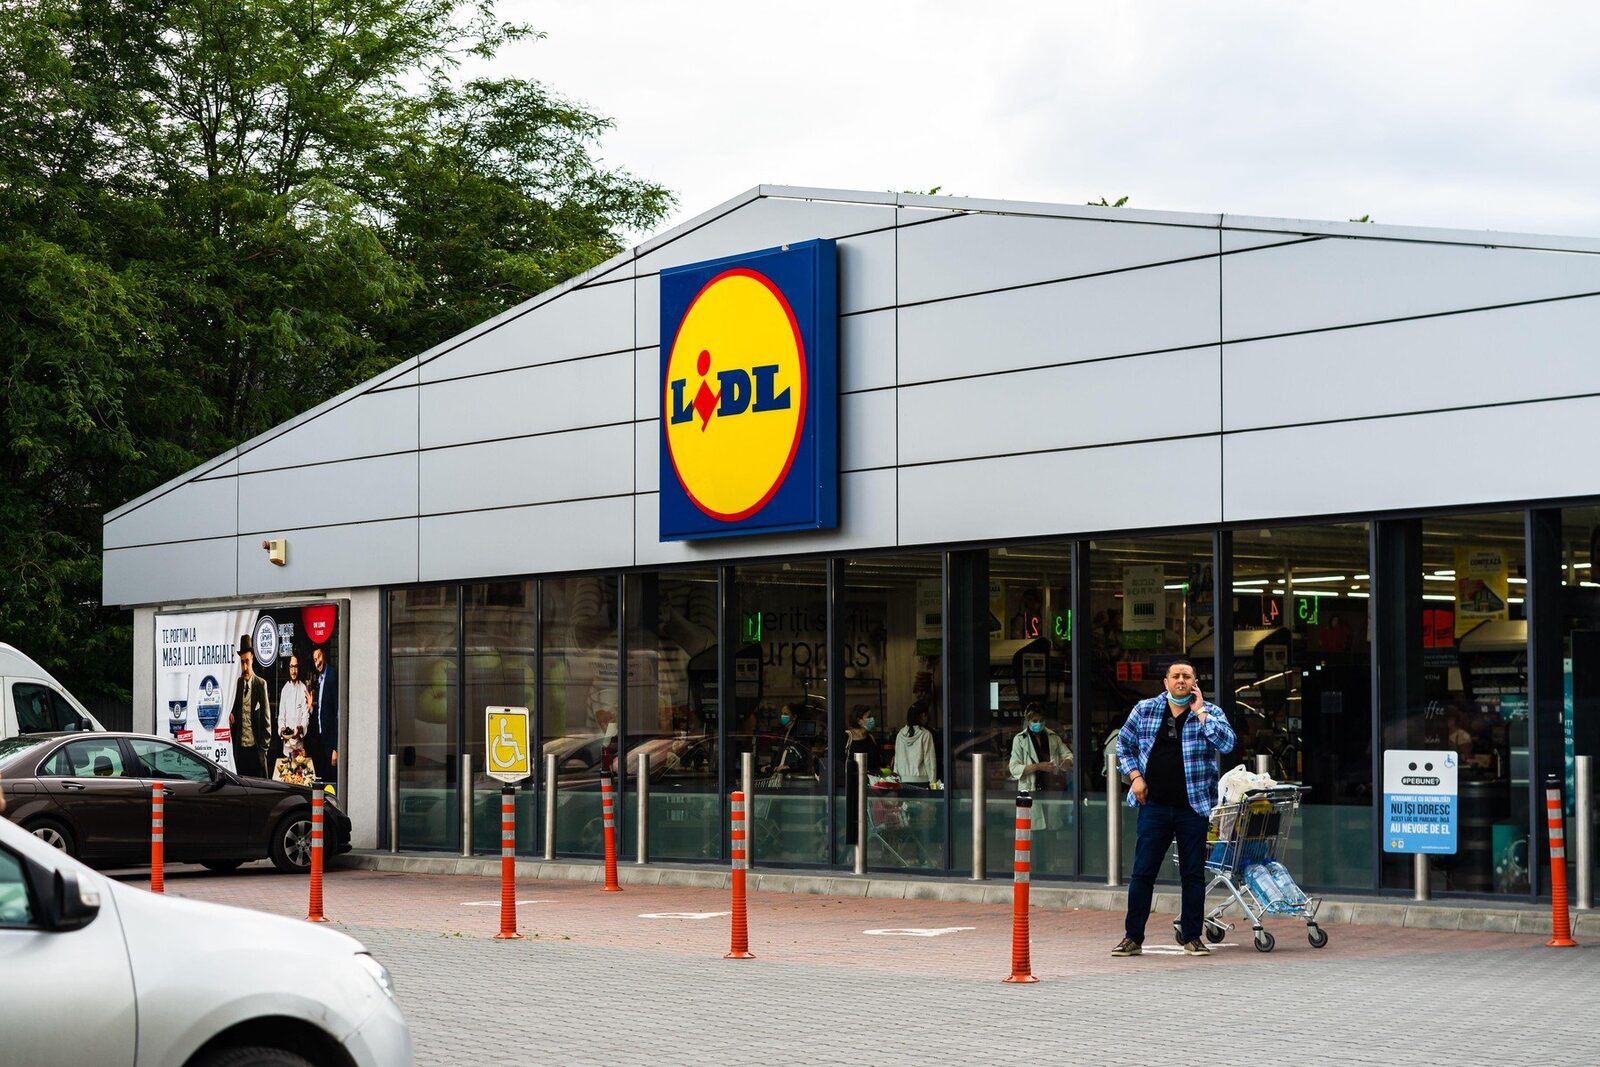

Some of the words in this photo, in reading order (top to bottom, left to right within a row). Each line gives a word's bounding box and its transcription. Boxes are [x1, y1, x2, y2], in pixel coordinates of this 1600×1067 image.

[162, 629, 169, 644] TE
[170, 628, 189, 643] POFTIM
[190, 627, 197, 642] LA
[162, 647, 182, 666] MASA
[184, 646, 196, 666] LUI
[197, 644, 235, 665] CARAGIALE
[1391, 804, 1402, 814] NU
[1418, 804, 1450, 814] DORESC
[1390, 823, 1401, 833] AU
[1402, 823, 1428, 833] NEVOIE
[1430, 824, 1440, 834] DE
[1441, 824, 1450, 834] EL
